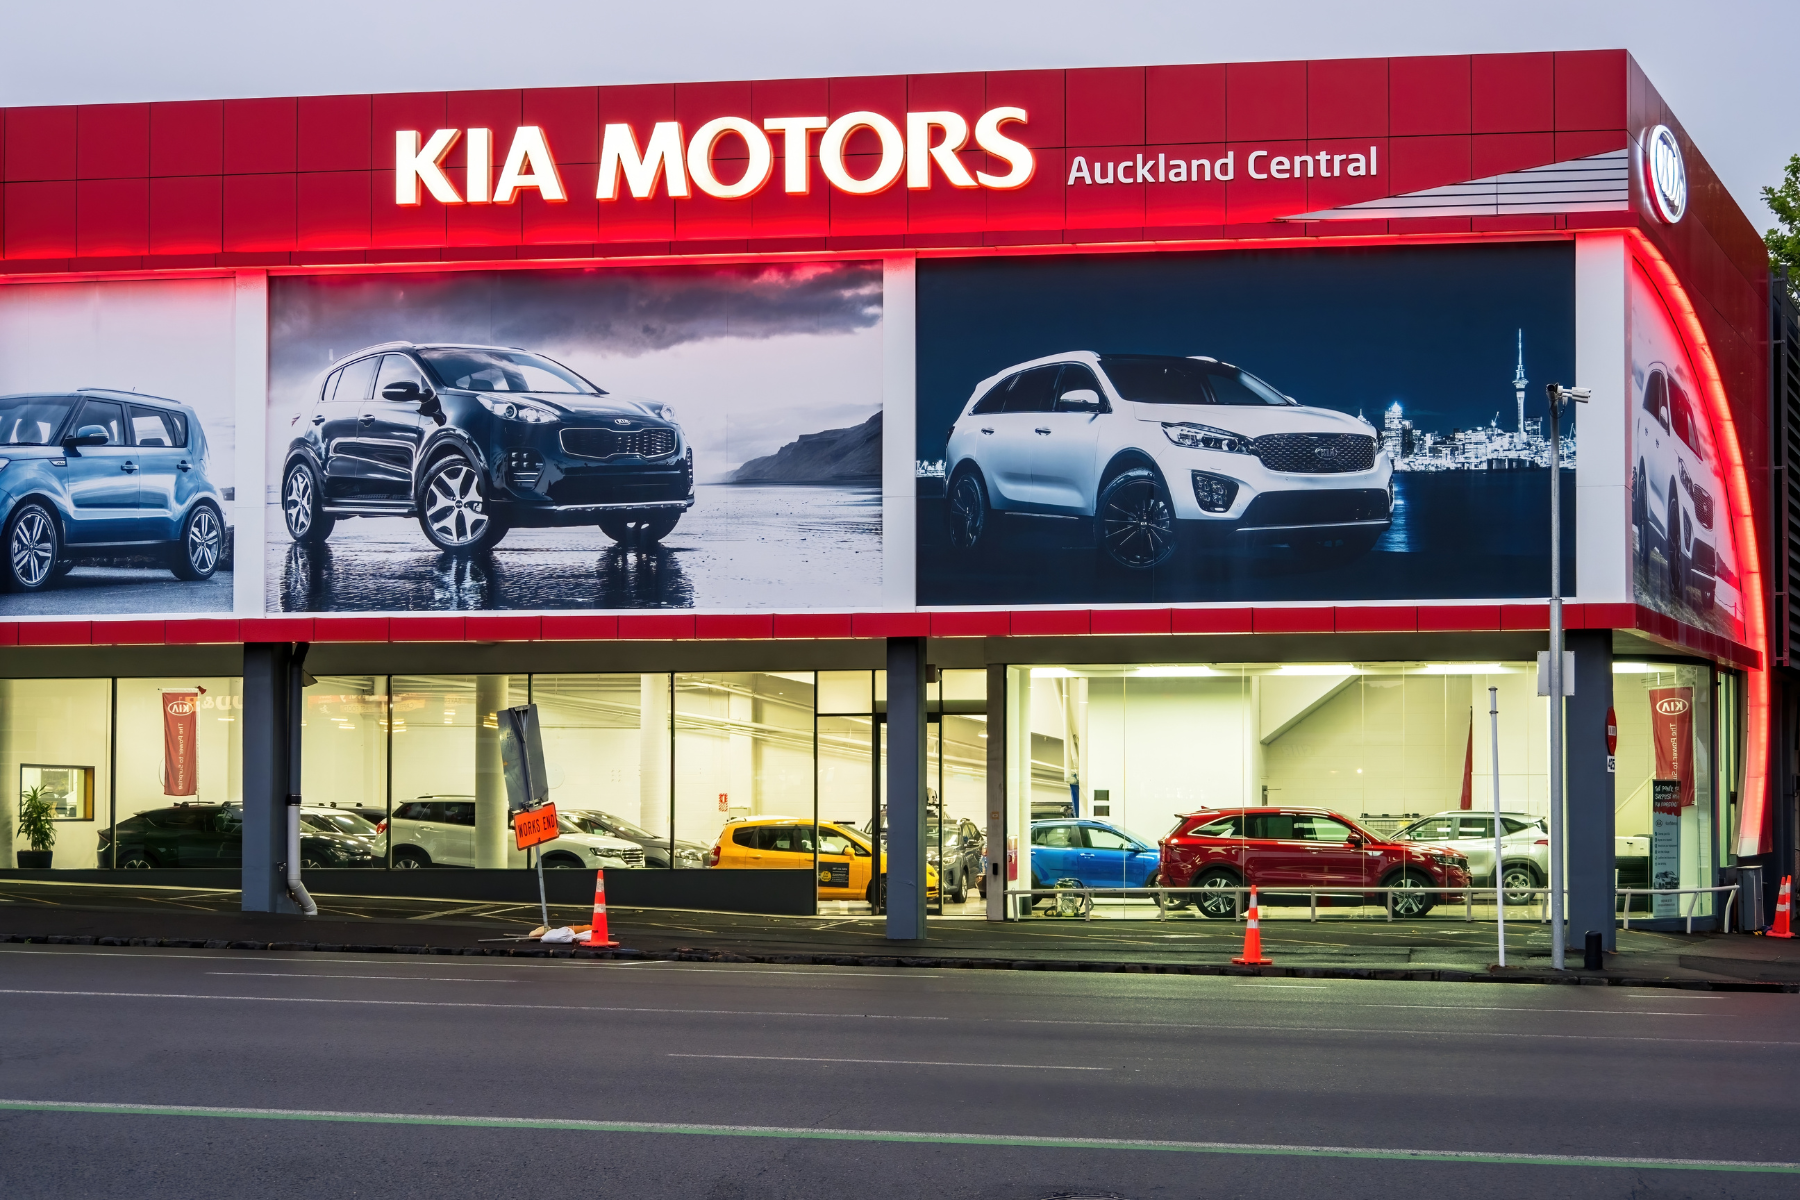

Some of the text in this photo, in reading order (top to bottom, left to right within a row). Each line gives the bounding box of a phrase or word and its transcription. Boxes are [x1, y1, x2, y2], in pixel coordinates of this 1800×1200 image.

[395, 106, 1037, 206] KIA MOTORS
[1066, 146, 1378, 186] Auckland Central
[517, 814, 556, 838] WORKS END
